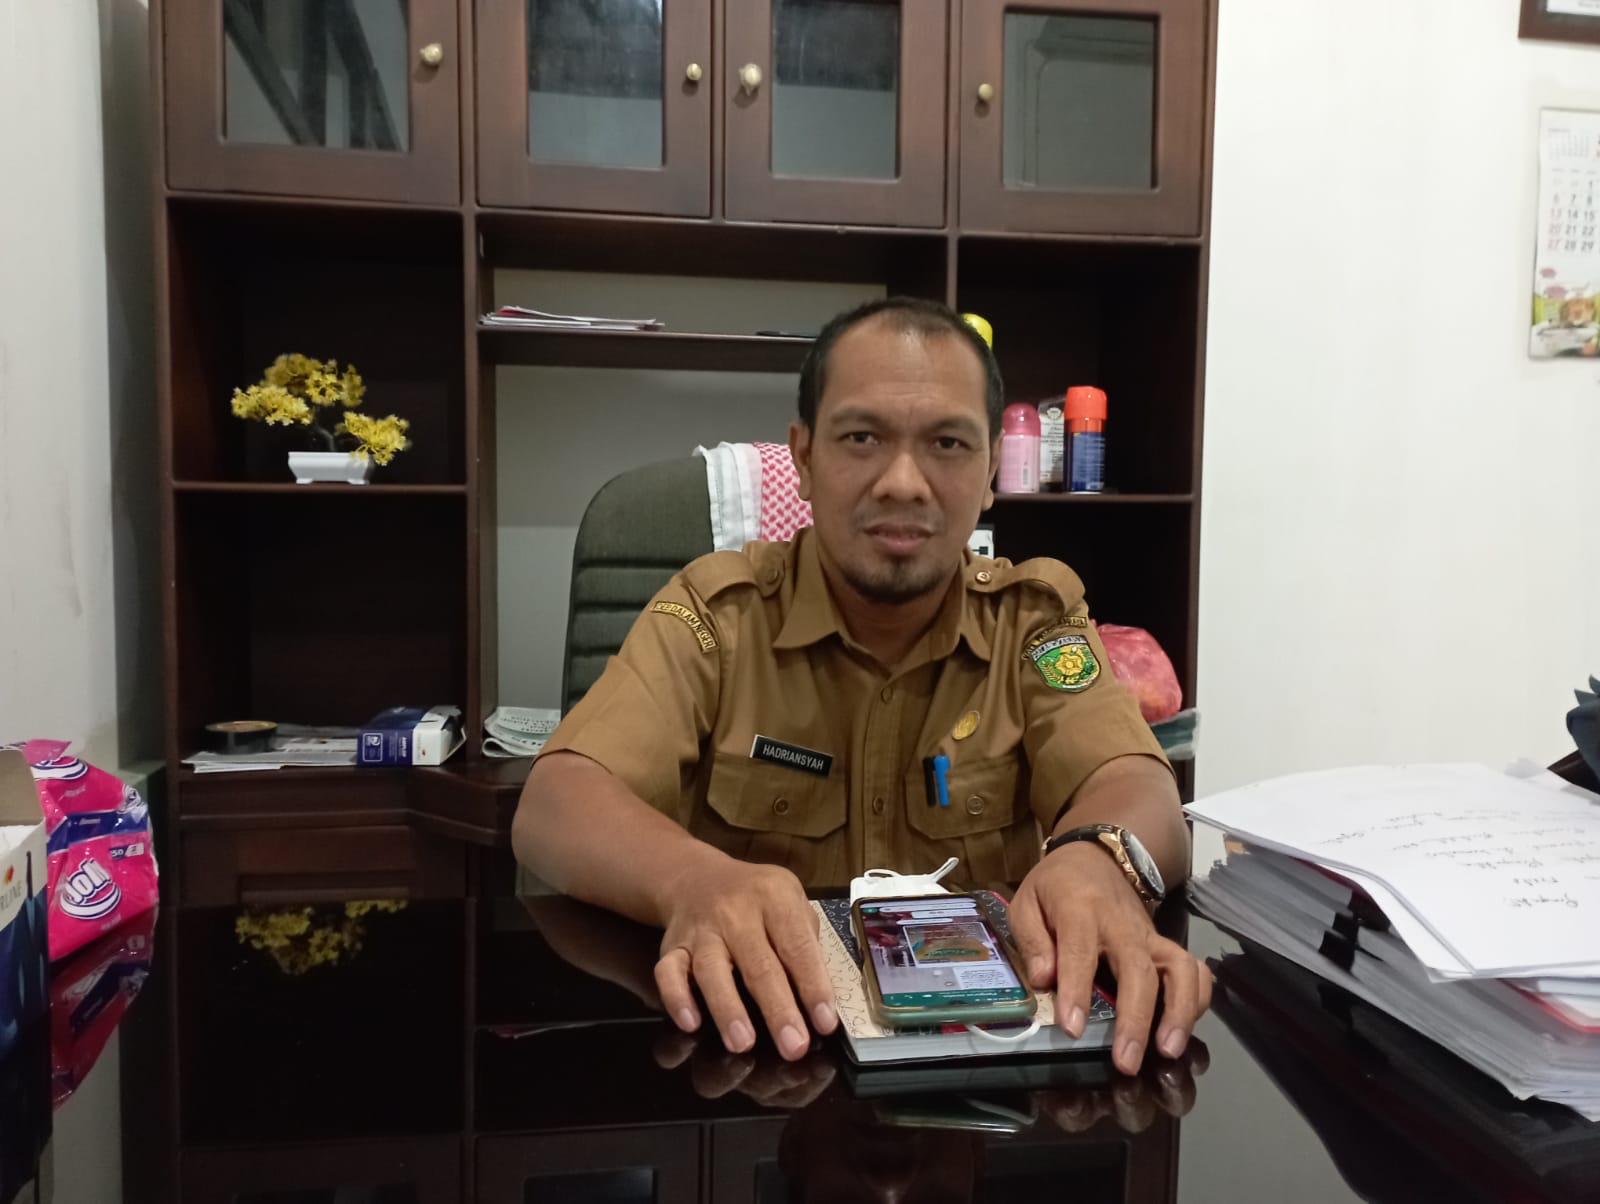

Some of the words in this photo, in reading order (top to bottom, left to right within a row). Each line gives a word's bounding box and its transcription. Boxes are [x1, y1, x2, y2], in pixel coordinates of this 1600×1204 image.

[1567, 208, 1579, 220] 14
[1584, 209, 1595, 222] 15
[1564, 224, 1577, 236] 21
[1581, 225, 1594, 237] 22
[1547, 239, 1561, 250] 27
[1564, 240, 1577, 252] 28
[1580, 241, 1595, 253] 29
[762, 744, 824, 770] HADRIANSYAH
